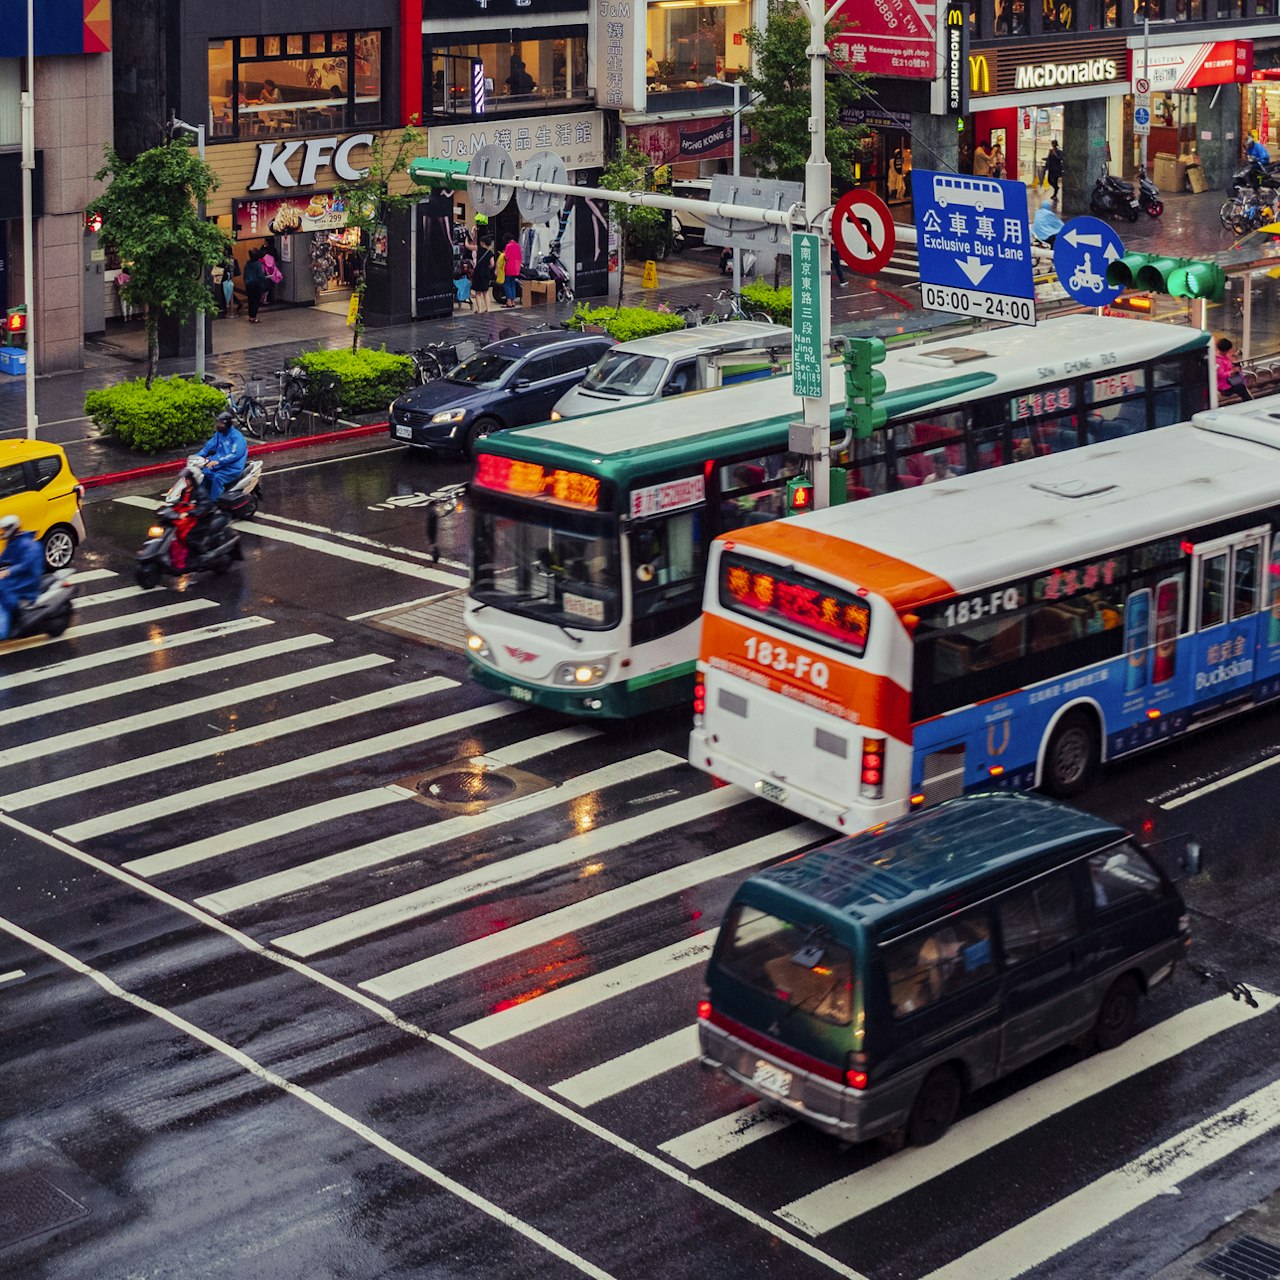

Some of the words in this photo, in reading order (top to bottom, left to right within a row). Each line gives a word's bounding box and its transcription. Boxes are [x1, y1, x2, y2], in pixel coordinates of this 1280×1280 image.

[599, 1, 631, 19] J&M
[950, 29, 960, 109] McDonald's
[1014, 57, 1117, 90] McDonald's
[440, 131, 487, 159] J&M
[249, 133, 376, 192] KFC
[328, 213, 342, 223] 299
[922, 208, 1024, 245] 公車專用
[923, 236, 971, 254] Exclusive
[974, 239, 995, 258] Bus
[998, 243, 1024, 262] Lane
[800, 247, 813, 335] 南京東路三段
[794, 334, 811, 344] Nan
[794, 343, 813, 356] Jing
[794, 352, 802, 362] E.
[804, 353, 817, 363] Rd.
[794, 362, 811, 372] Sec.
[814, 364, 820, 373] 3
[1099, 351, 1117, 365] BUS
[794, 371, 806, 381] 184
[808, 372, 821, 383] 189
[794, 385, 807, 395] 224
[808, 386, 821, 397] 225
[1017, 386, 1072, 420] 三重客運
[944, 587, 1019, 628] 183-FQ
[743, 636, 830, 689] 183-FQ
[1195, 658, 1254, 691] Buckskin
